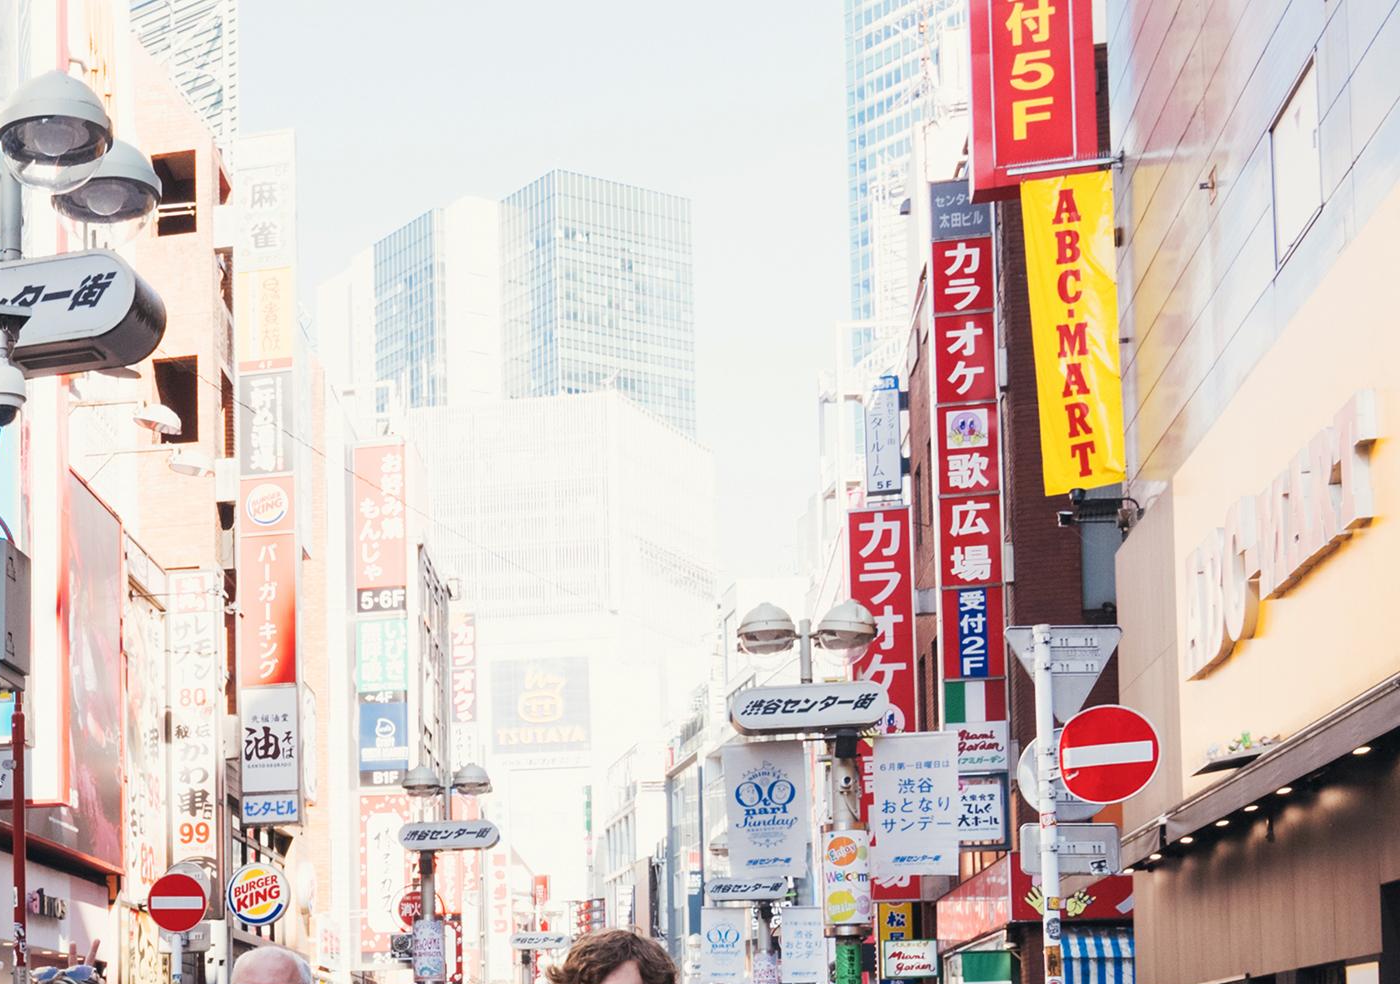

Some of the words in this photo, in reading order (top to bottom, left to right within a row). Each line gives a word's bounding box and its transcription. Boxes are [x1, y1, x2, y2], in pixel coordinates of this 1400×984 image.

[250, 181, 281, 249] 麻雀
[939, 211, 984, 229] 太田ビル
[943, 242, 986, 396] カラオケ
[252, 499, 284, 517] KING
[946, 453, 992, 583] 歌広場
[359, 497, 383, 581] もんじゃ
[257, 544, 279, 678] バーガーキング
[958, 589, 987, 677] 受付2F
[740, 692, 878, 718] 渋谷センター街
[174, 724, 211, 739] 秘伝
[496, 724, 586, 747] TSUTAYA
[371, 770, 399, 785] B1F
[898, 776, 934, 794] 渋谷
[244, 799, 297, 817] センタービル
[881, 796, 951, 814] おとなり
[963, 803, 993, 814] てんぐ
[735, 814, 799, 830] Sunday
[881, 815, 952, 834] サンデー
[958, 814, 1000, 827] 大ホール
[179, 821, 210, 845] 99
[403, 827, 492, 841] 渋谷センター街
[233, 874, 278, 898] BURGER
[709, 880, 783, 896] 渋谷センター街
[235, 886, 281, 916] KING
[888, 951, 926, 960] Miami
